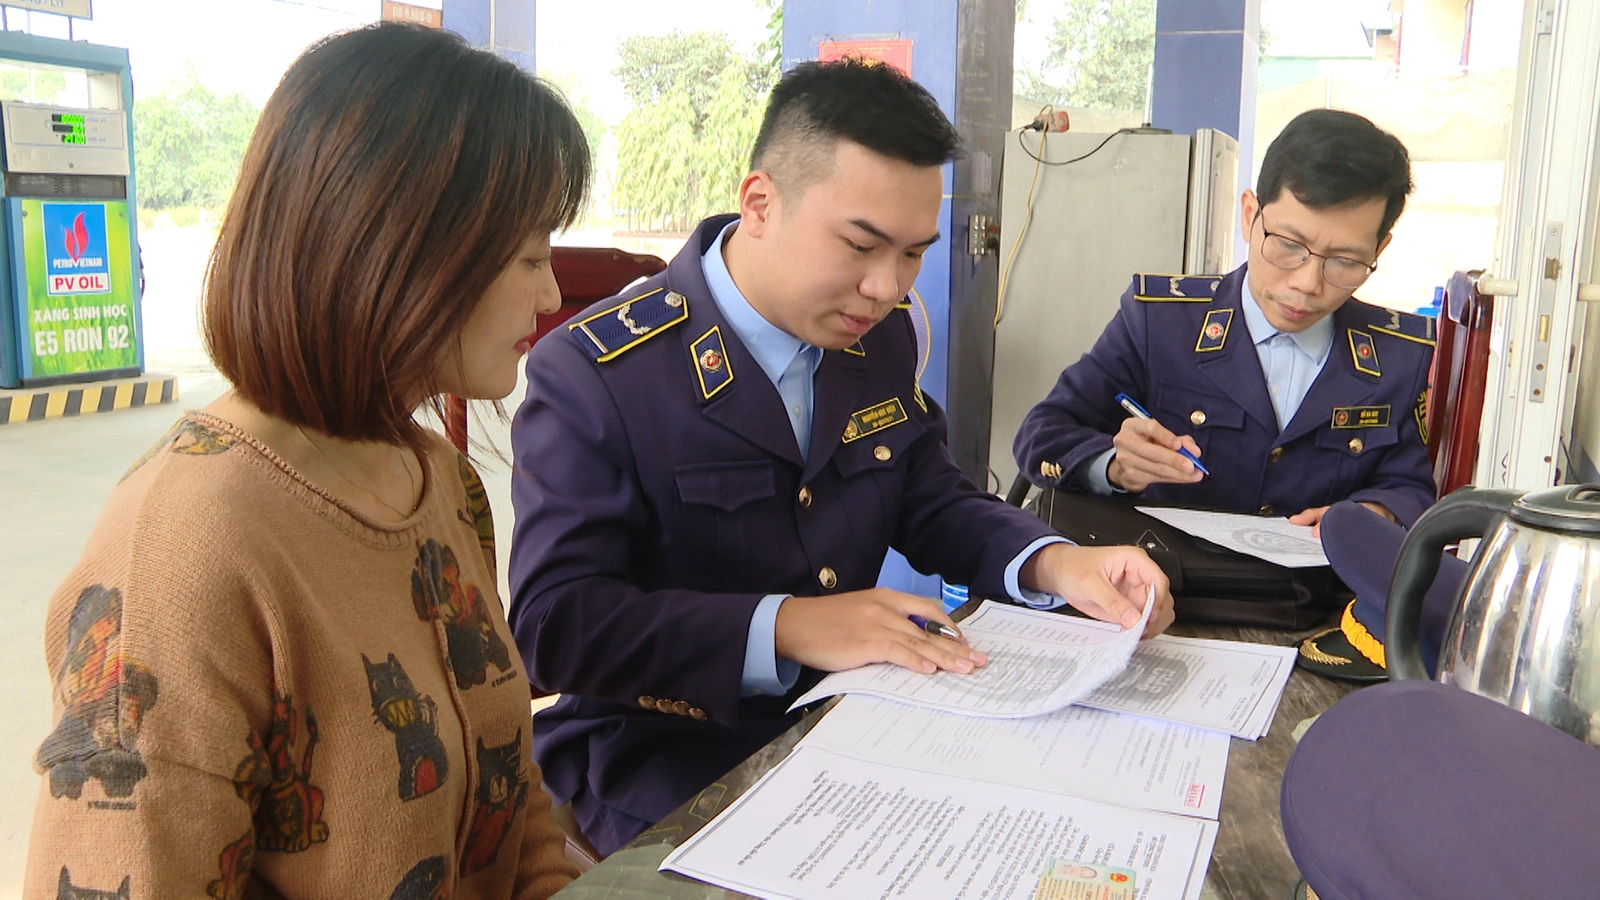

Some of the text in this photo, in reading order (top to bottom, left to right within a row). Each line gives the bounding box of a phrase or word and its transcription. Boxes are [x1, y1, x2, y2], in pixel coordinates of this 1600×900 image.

[53, 257, 103, 269] PETROVIETNAM
[54, 275, 104, 291] PV OIL
[73, 306, 101, 321] SINH
[103, 303, 128, 320] HỌC
[35, 324, 130, 357] E5 RON 92
